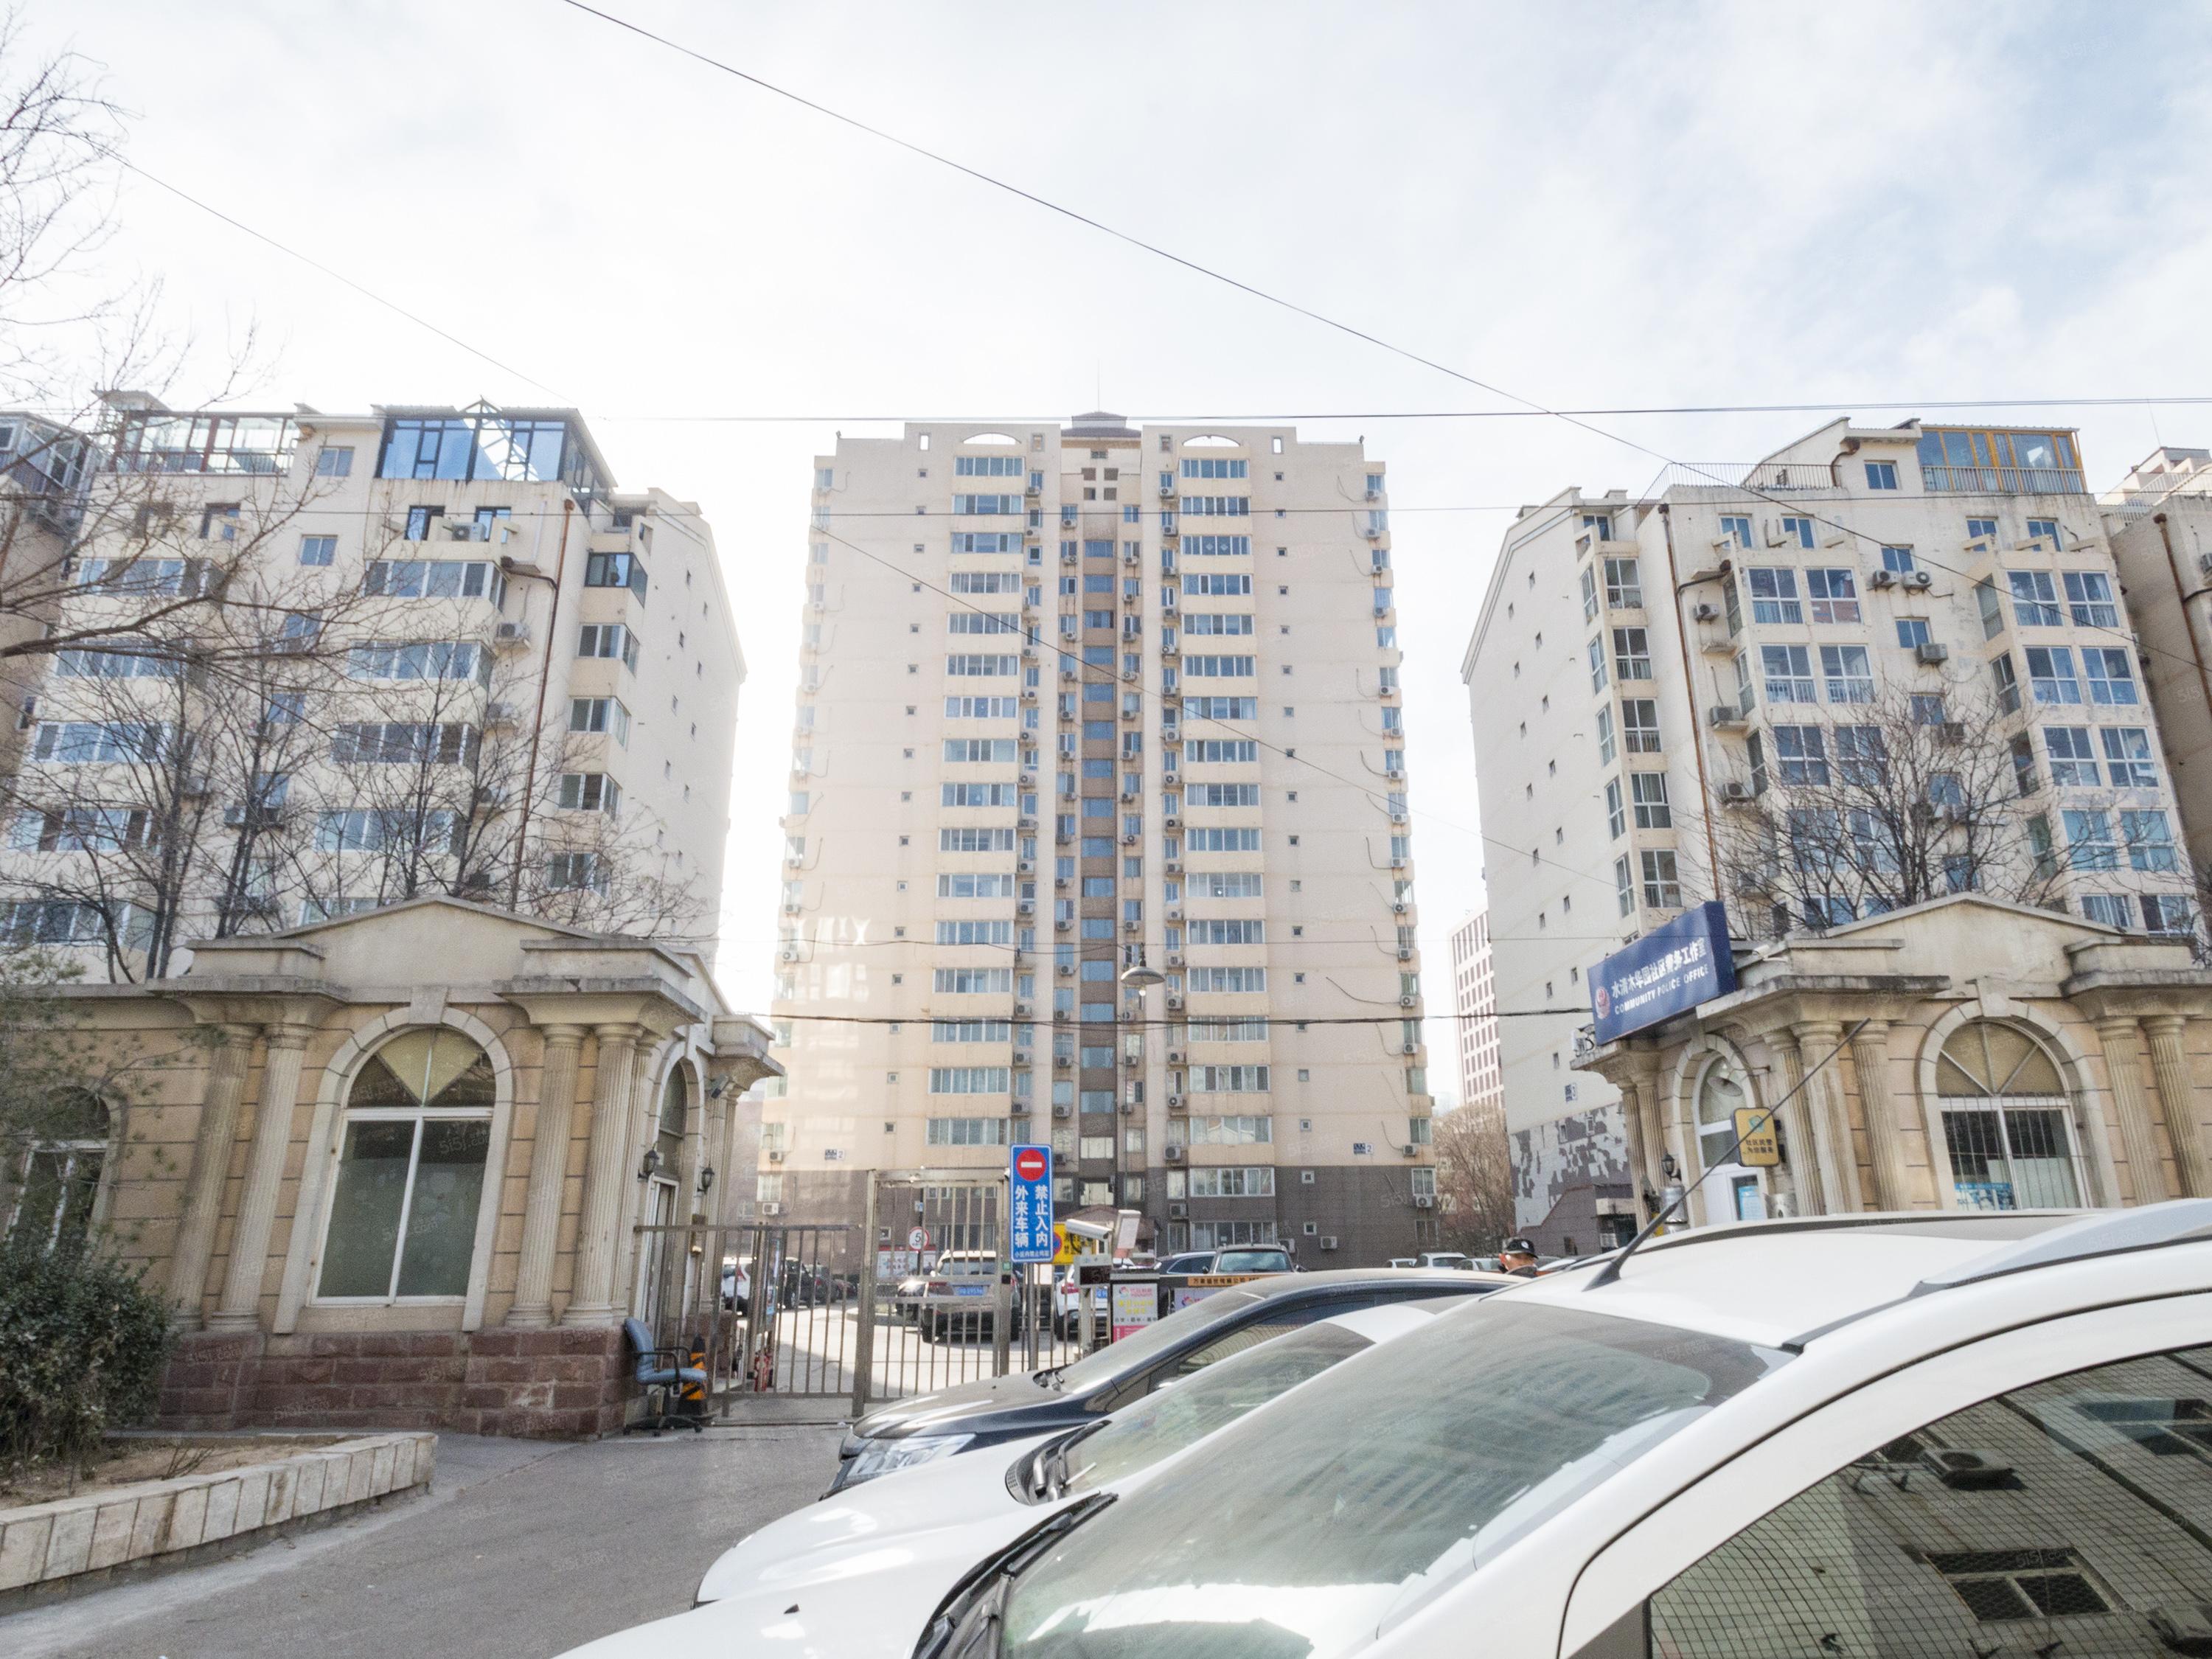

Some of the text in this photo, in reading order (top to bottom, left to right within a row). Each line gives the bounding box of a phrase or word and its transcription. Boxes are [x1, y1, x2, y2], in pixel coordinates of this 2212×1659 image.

[1612, 937, 1706, 998] 水清木华园社区警务工作室
[1615, 964, 1709, 1015] COMMUNITY POLICE OFFICE
[1015, 1185, 1029, 1248] 外来车辆
[1034, 1184, 1048, 1247] 禁止入内
